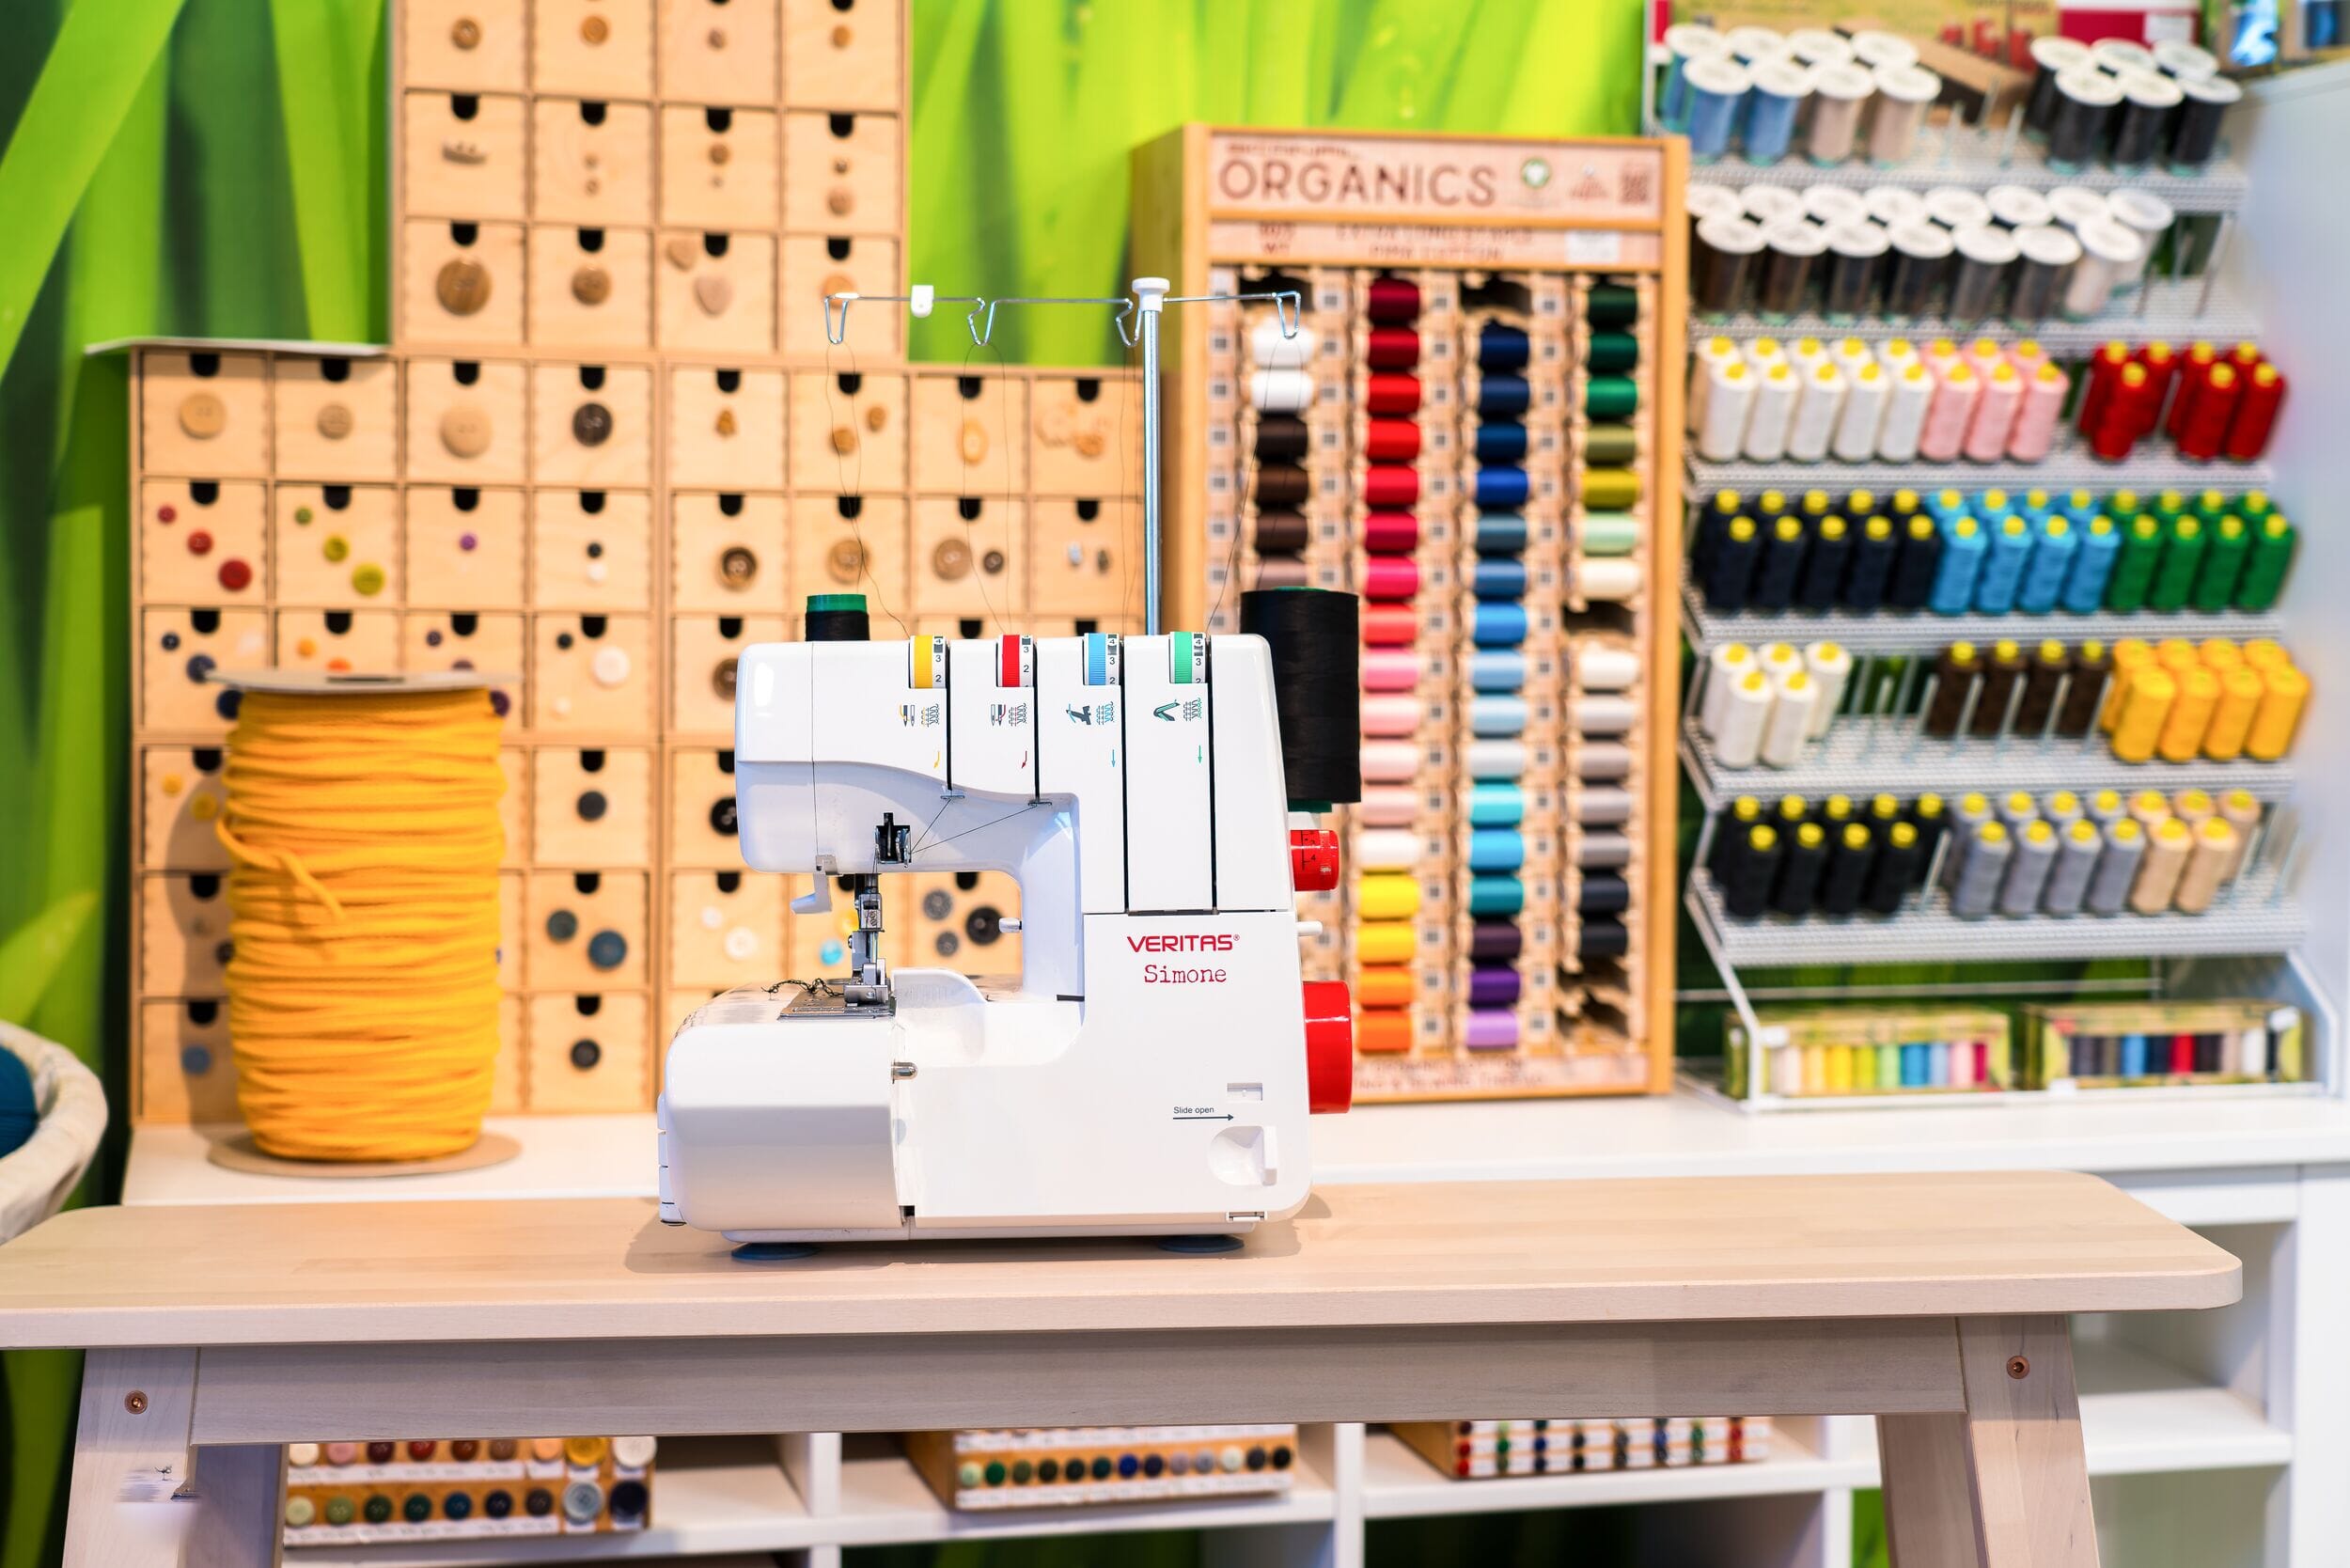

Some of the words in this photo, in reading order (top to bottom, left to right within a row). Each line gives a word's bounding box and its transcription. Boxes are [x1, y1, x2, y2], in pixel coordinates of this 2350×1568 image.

[1219, 159, 1497, 208] ORGANICS
[935, 654, 942, 663] 3
[1109, 656, 1116, 666] 3
[1195, 657, 1201, 666] 3
[1023, 664, 1029, 673] 2
[935, 674, 942, 682] 2
[1109, 676, 1116, 684] 2
[1144, 964, 1227, 983] Simone
[1173, 1105, 1193, 1114] Slide
